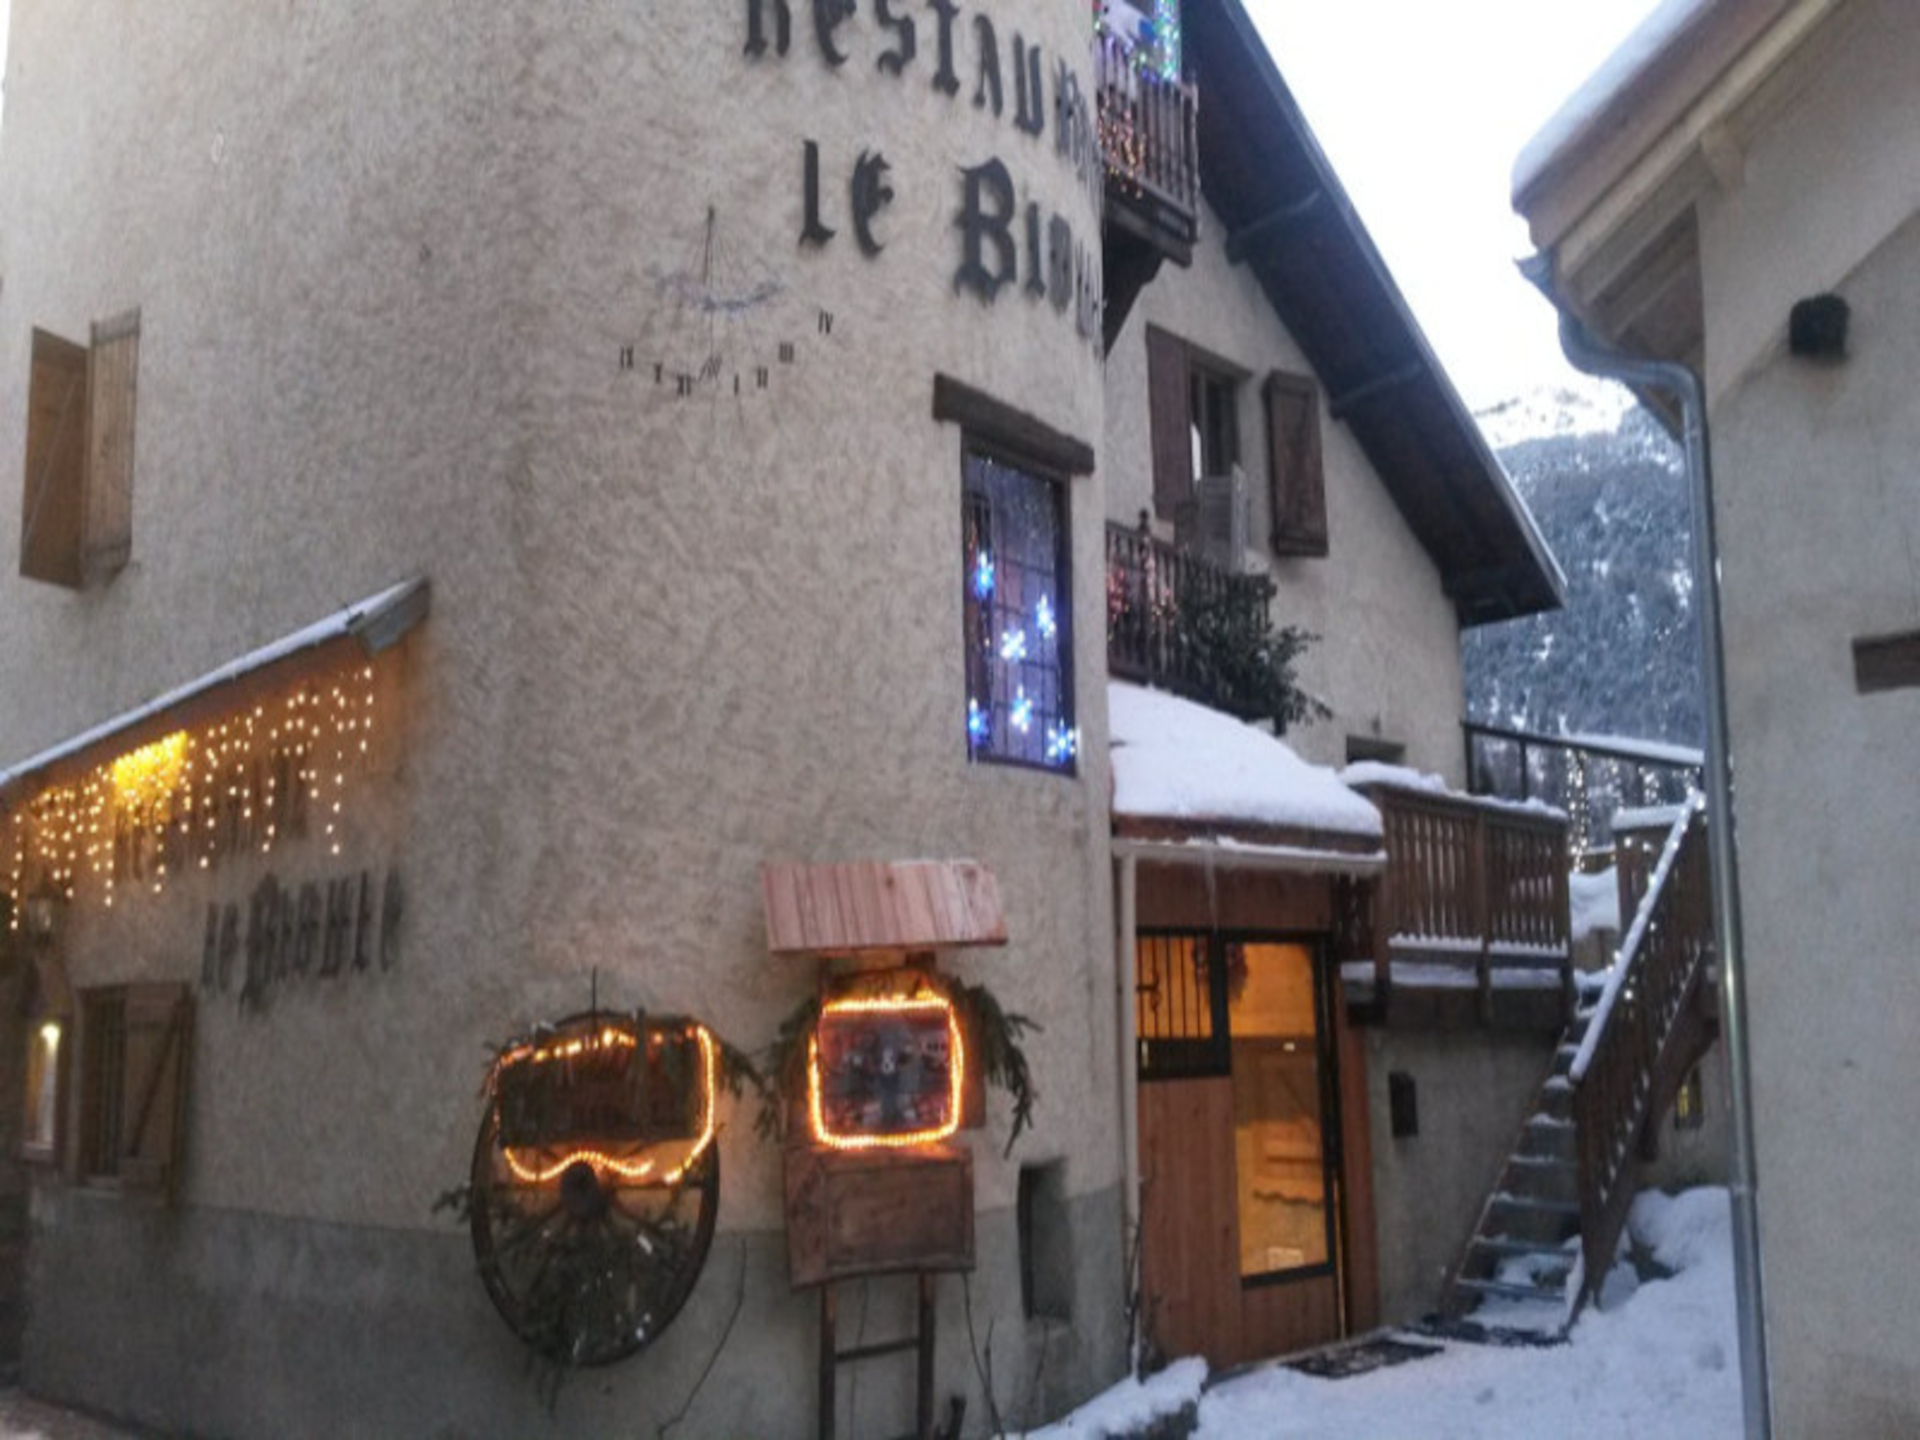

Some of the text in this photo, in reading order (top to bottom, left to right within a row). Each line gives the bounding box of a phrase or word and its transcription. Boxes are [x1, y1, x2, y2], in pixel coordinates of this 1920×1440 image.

[819, 310, 833, 334] IV
[778, 341, 794, 364] III
[757, 367, 768, 389] II
